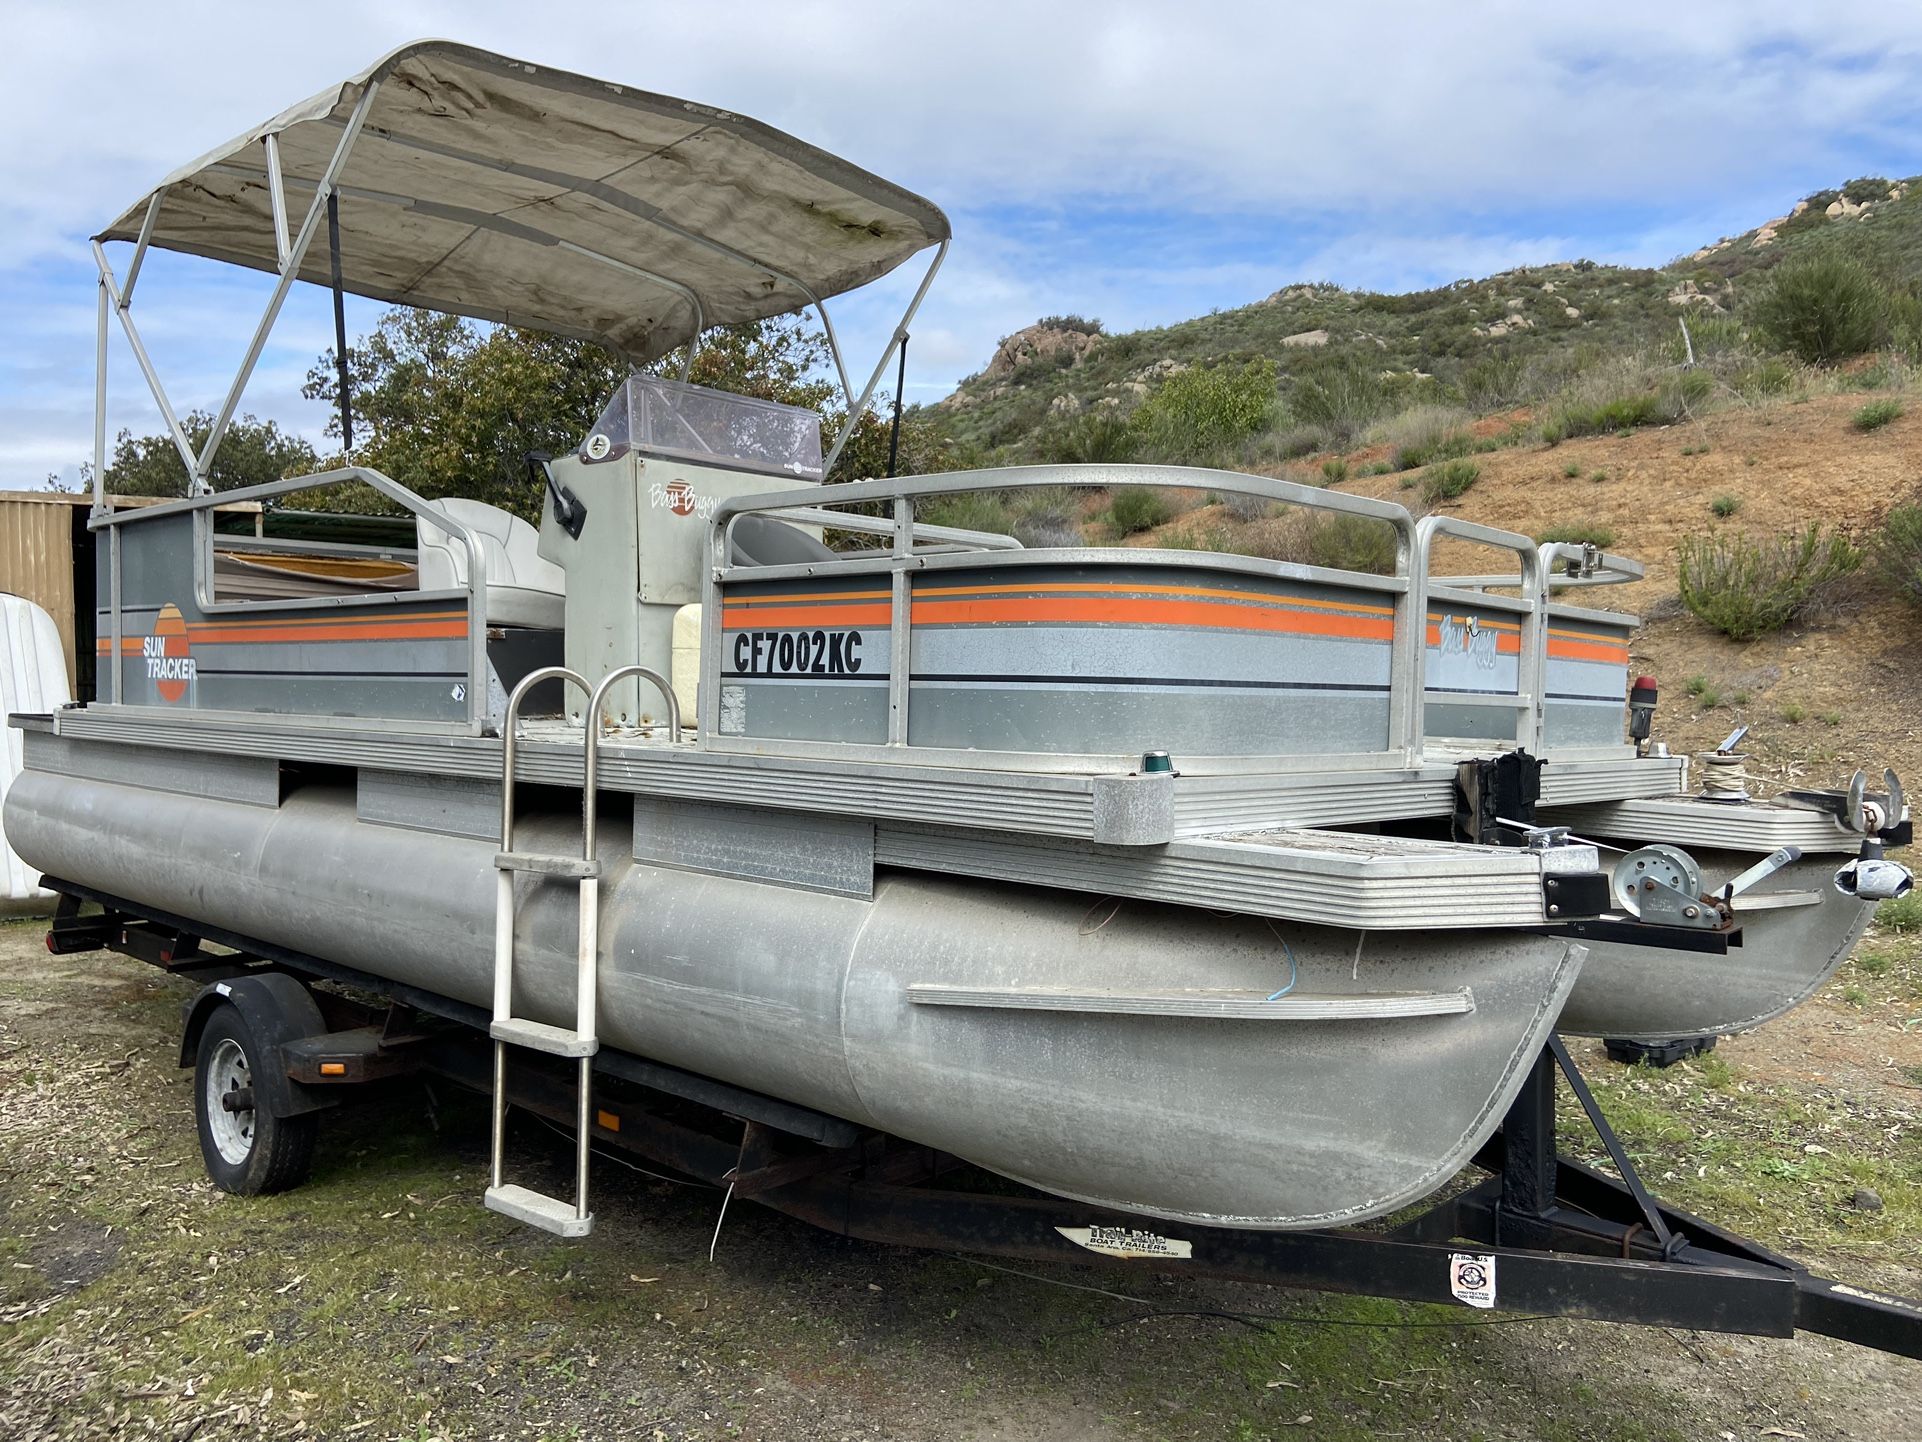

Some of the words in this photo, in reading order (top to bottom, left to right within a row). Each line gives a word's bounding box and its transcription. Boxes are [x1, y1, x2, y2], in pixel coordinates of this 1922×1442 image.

[648, 483, 679, 509] Bass
[143, 636, 166, 658] SUN
[734, 630, 863, 673] CF7002KC
[147, 658, 199, 680] TRACKER
[1089, 1237, 1116, 1245] BOAT
[1119, 1240, 1168, 1251] TRAILERS
